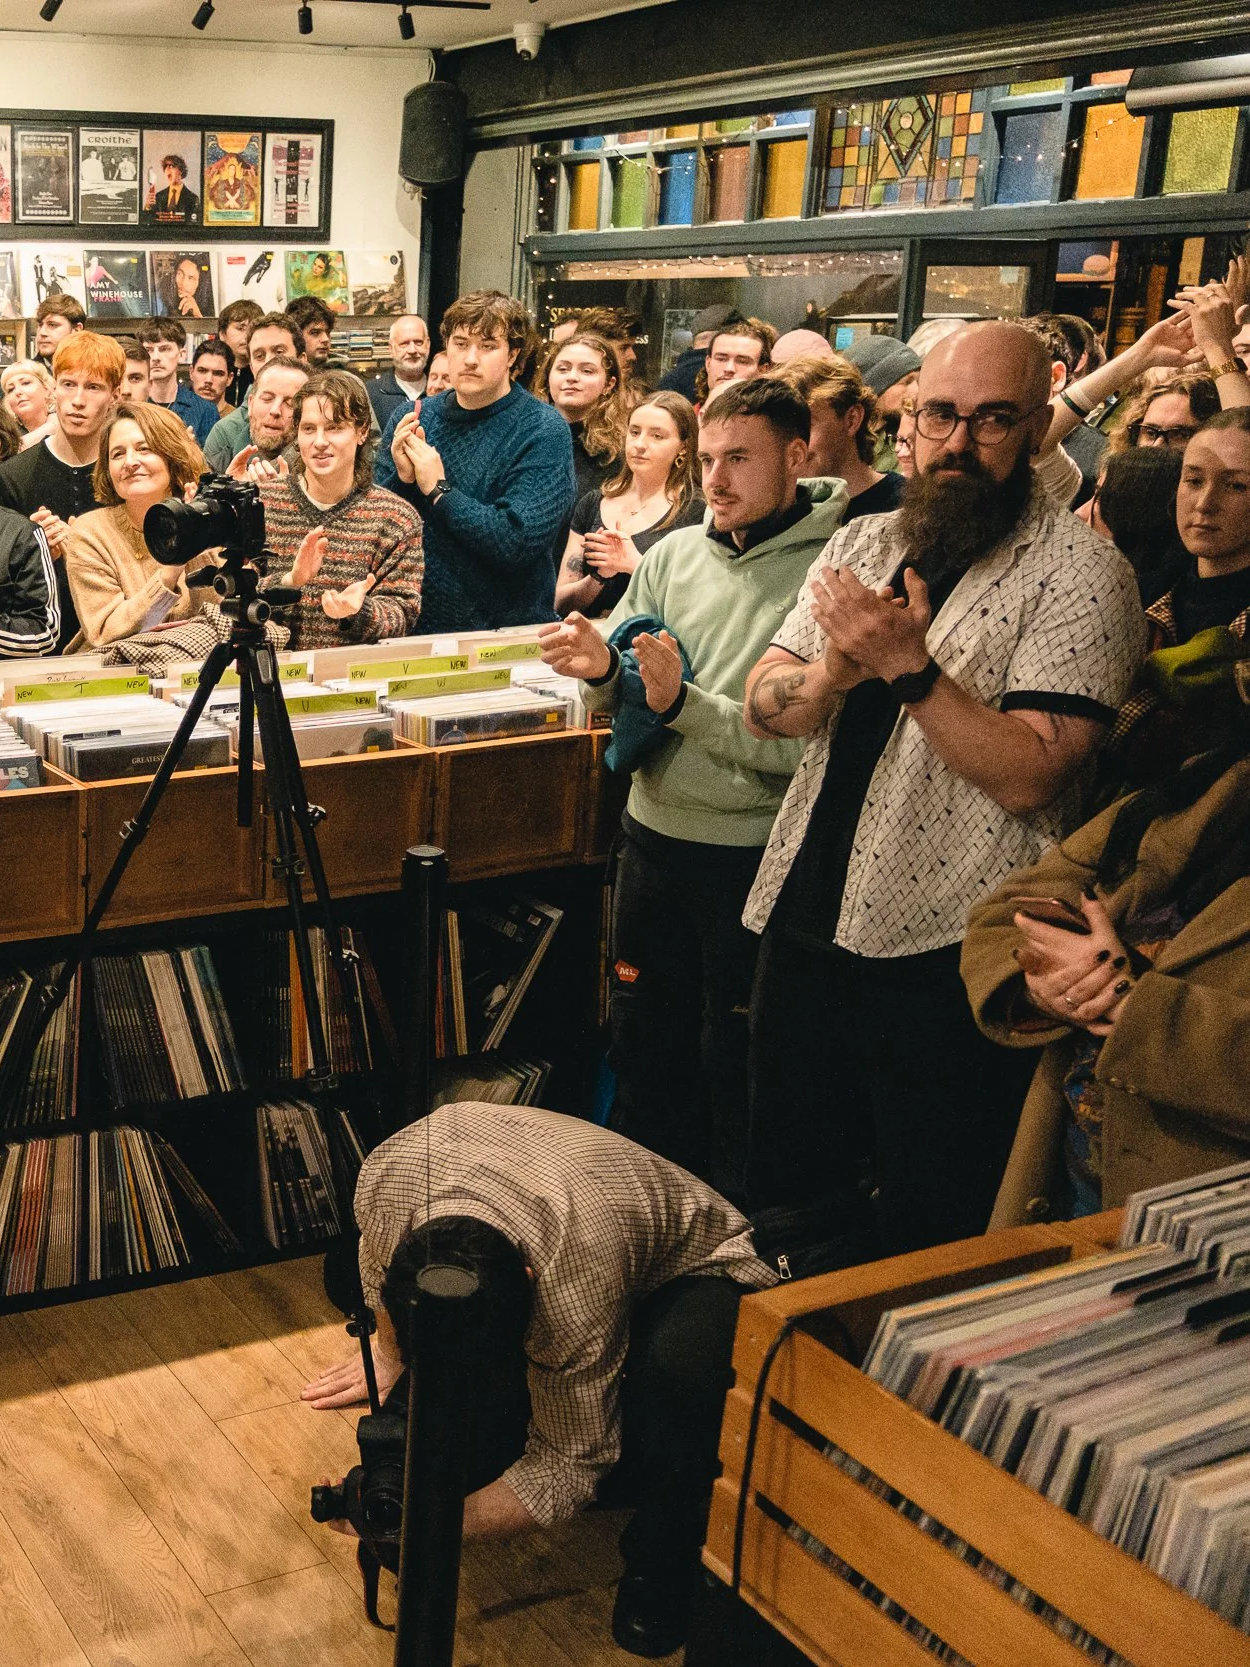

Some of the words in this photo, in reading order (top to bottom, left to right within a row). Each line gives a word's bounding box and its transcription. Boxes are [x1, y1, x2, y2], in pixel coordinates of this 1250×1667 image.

[90, 281, 110, 289] AMY
[90, 290, 144, 298] WINEHOUSE
[286, 667, 301, 677] NEW
[350, 669, 367, 680] NEW
[402, 662, 409, 675] V
[450, 660, 467, 670] NEW
[17, 690, 33, 700] NEW
[74, 682, 89, 694] T
[126, 680, 146, 689] NEW
[355, 696, 371, 705] NEW
